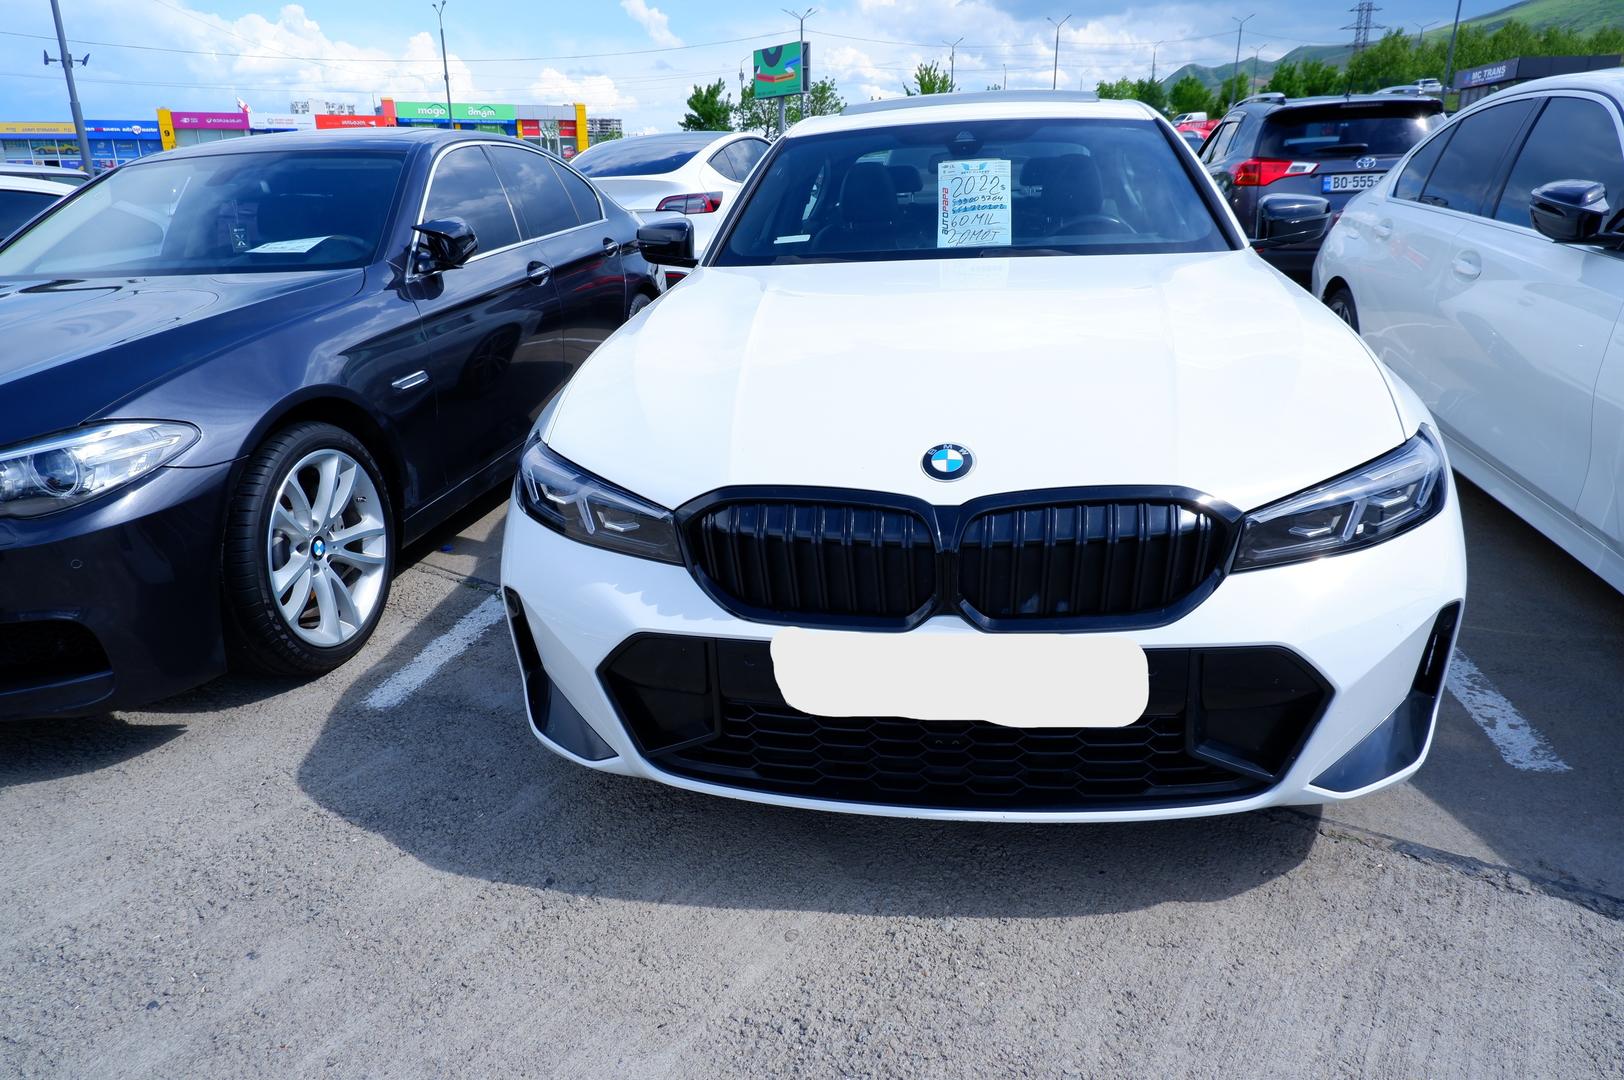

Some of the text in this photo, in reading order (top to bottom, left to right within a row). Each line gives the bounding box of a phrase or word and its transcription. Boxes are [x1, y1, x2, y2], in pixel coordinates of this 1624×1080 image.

[1472, 65, 1506, 80] MC TRANS
[418, 107, 445, 117] mogo
[927, 444, 969, 456] BMW
